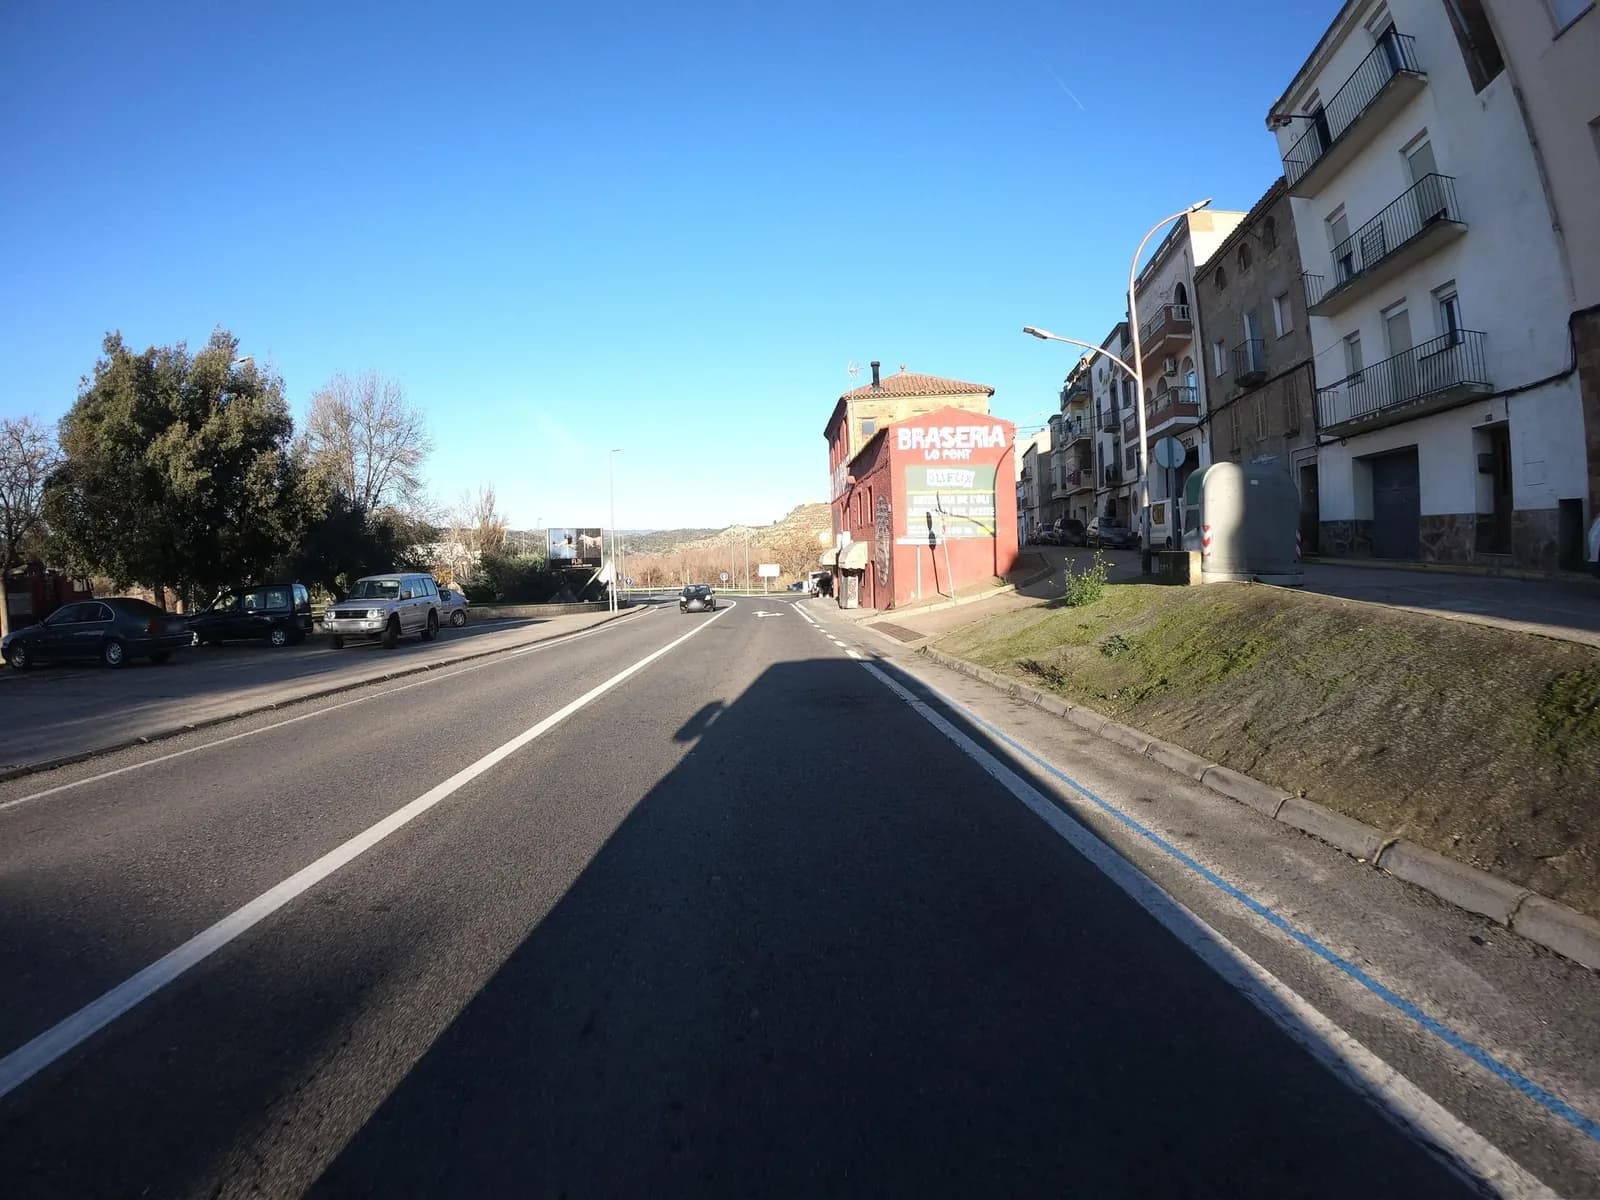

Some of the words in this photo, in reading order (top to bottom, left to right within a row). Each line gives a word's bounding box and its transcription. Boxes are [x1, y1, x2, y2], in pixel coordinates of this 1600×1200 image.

[897, 425, 1006, 450] BRASERIA
[924, 449, 940, 460] LO
[942, 449, 973, 460] PONT
